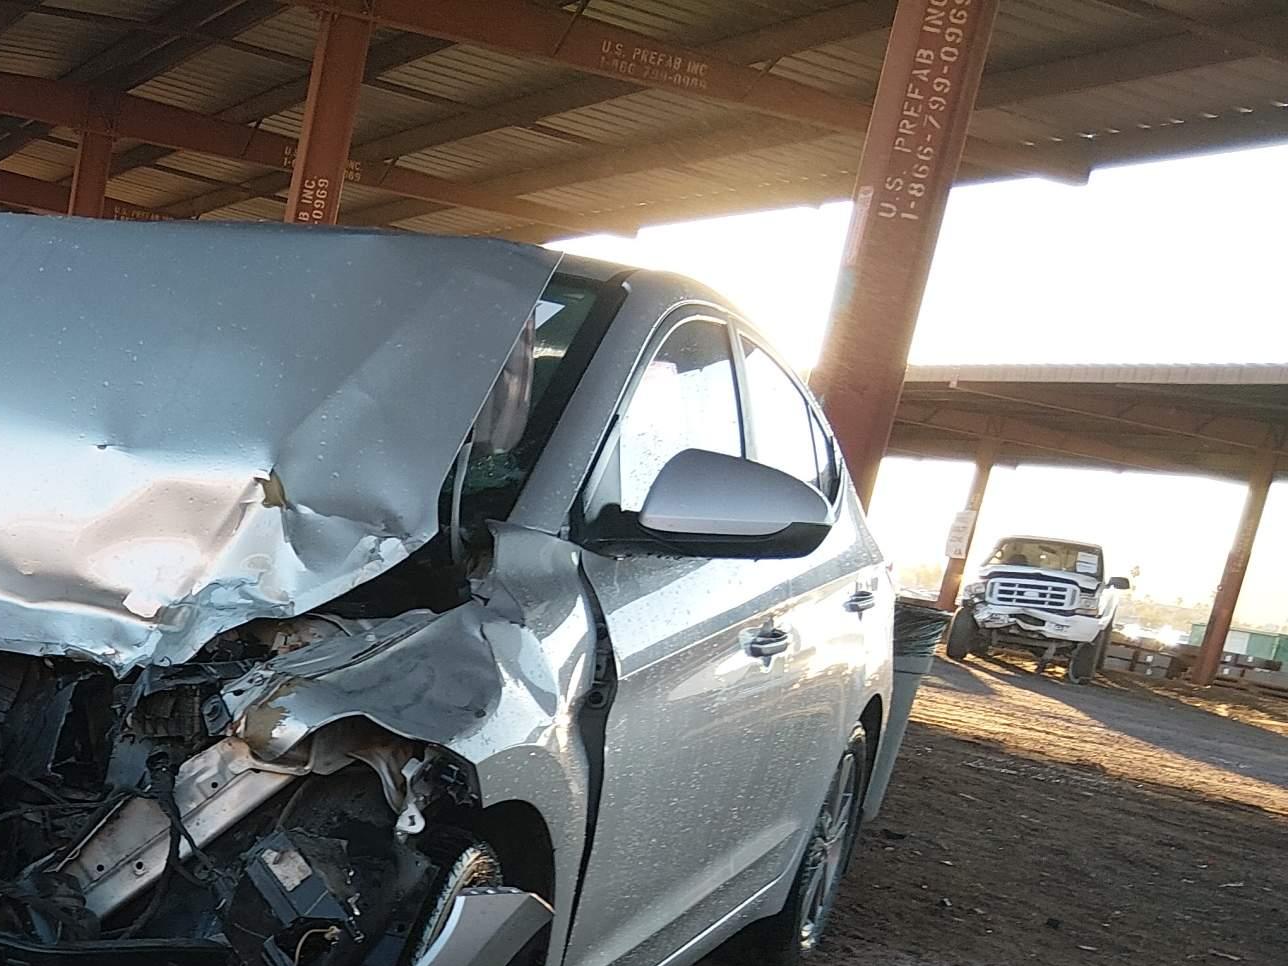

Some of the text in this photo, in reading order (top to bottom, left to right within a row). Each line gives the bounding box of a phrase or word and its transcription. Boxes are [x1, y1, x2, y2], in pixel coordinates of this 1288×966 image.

[601, 40, 625, 59] U.S.
[633, 48, 682, 71] PREFAB
[878, 170, 907, 218] U.S.
[894, 49, 934, 152] PREFAB
